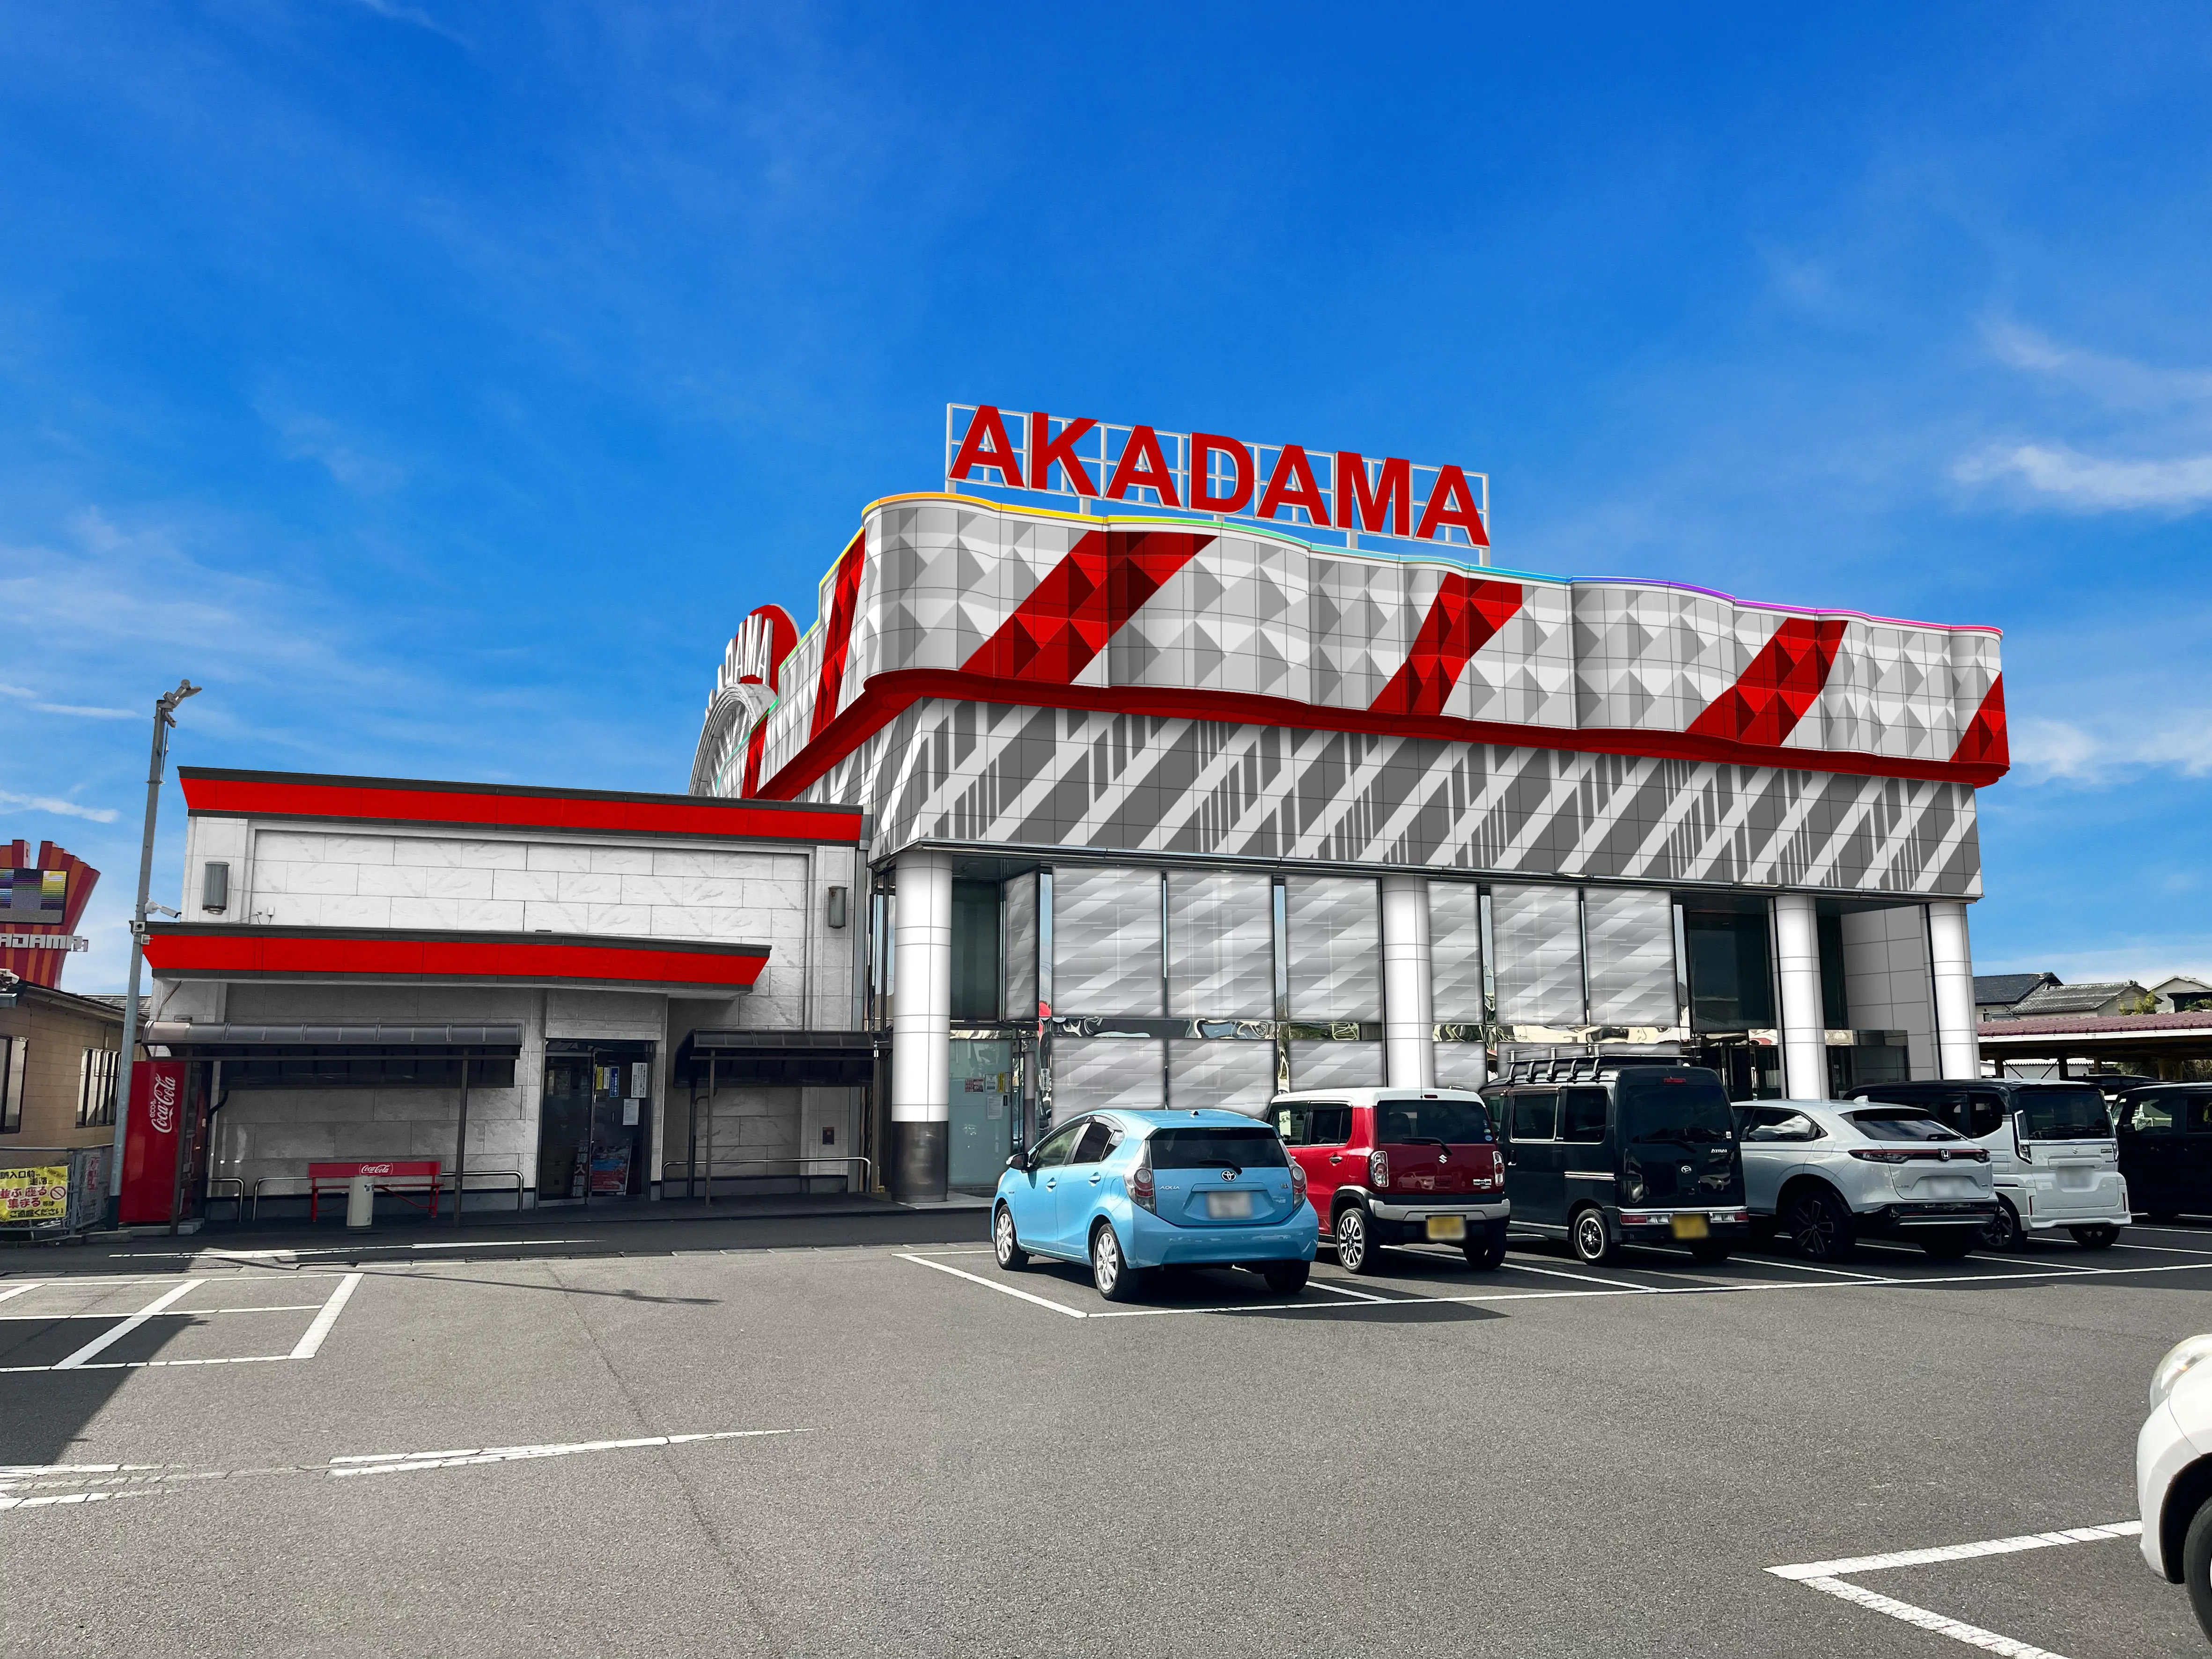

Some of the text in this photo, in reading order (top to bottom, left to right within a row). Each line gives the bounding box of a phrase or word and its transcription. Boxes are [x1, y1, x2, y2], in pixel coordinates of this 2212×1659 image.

[949, 405, 1490, 547] AKADAMA
[151, 1073, 176, 1133] Coca-Cola
[361, 1164, 391, 1174] Coca-Cola
